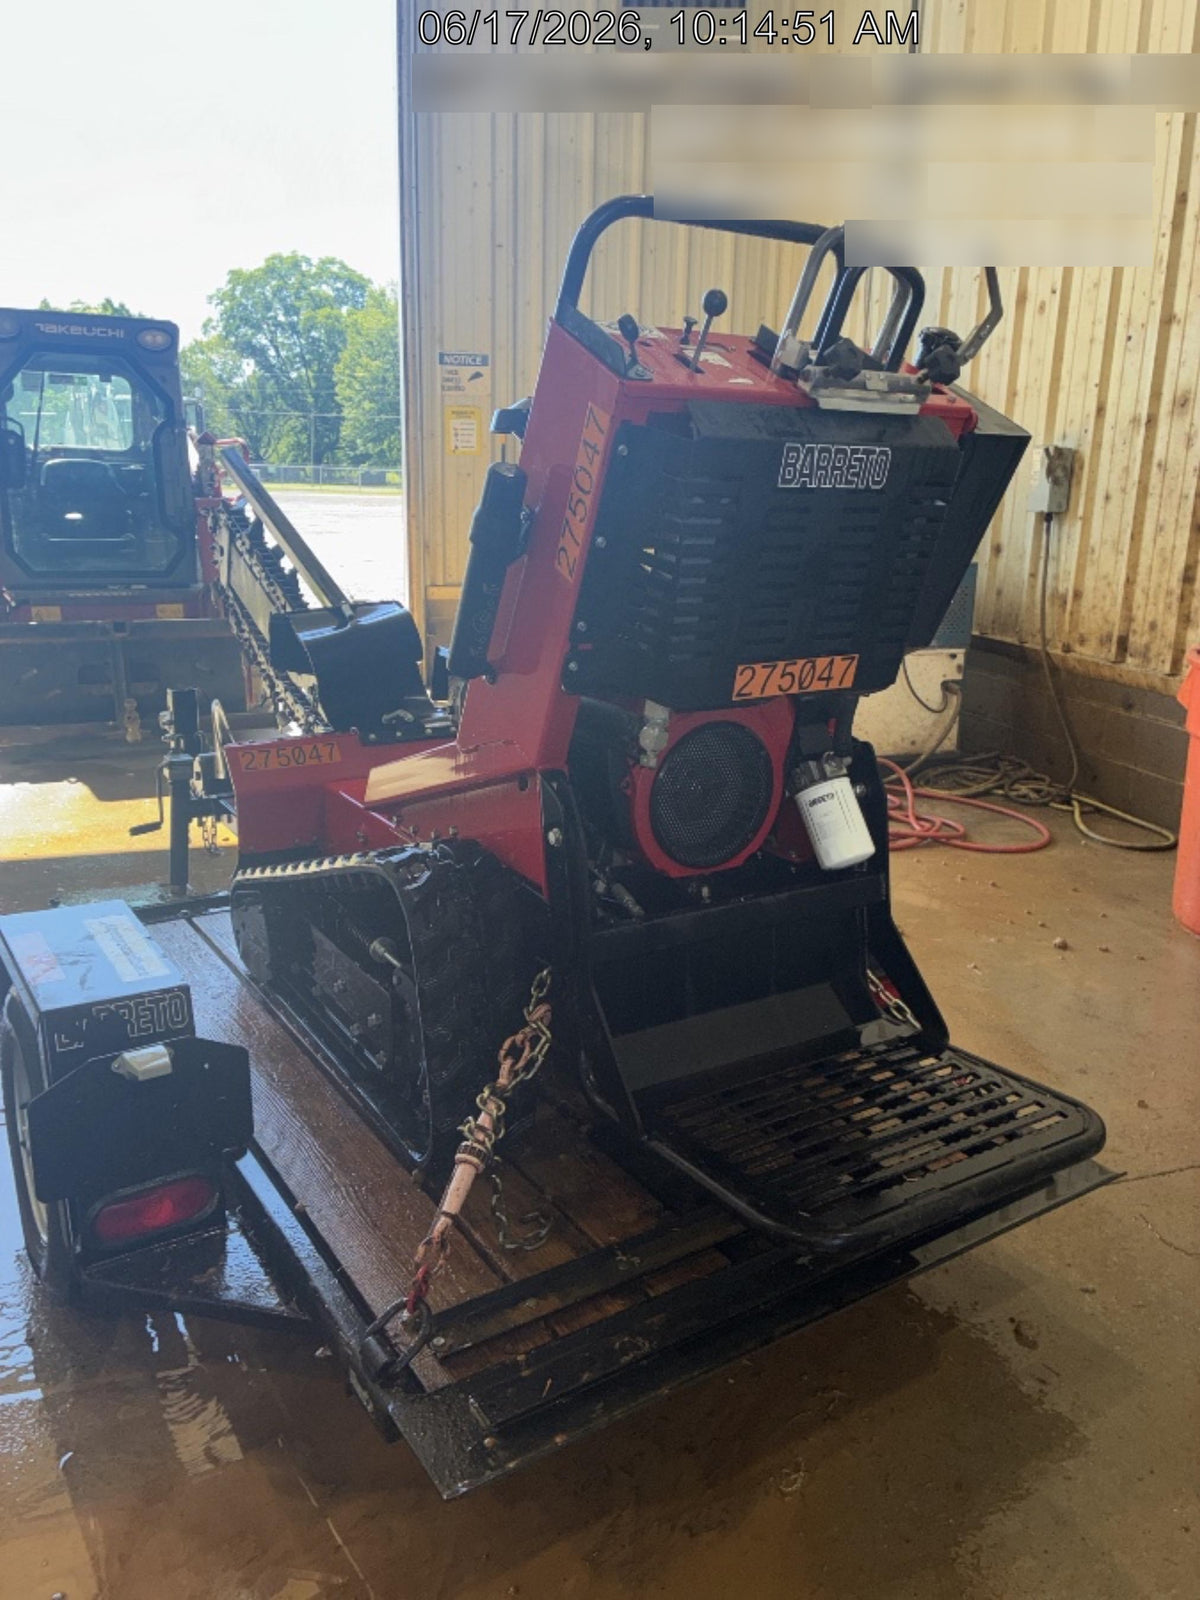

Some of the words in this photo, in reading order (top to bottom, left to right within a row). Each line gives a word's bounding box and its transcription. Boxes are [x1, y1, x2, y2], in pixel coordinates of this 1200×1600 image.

[35, 322, 125, 339] TAKEUCHI
[444, 354, 483, 365] NOTICE
[777, 441, 892, 490] BARRETO
[556, 405, 605, 577] 275047
[735, 655, 857, 698] 275047
[241, 742, 336, 771] 275047
